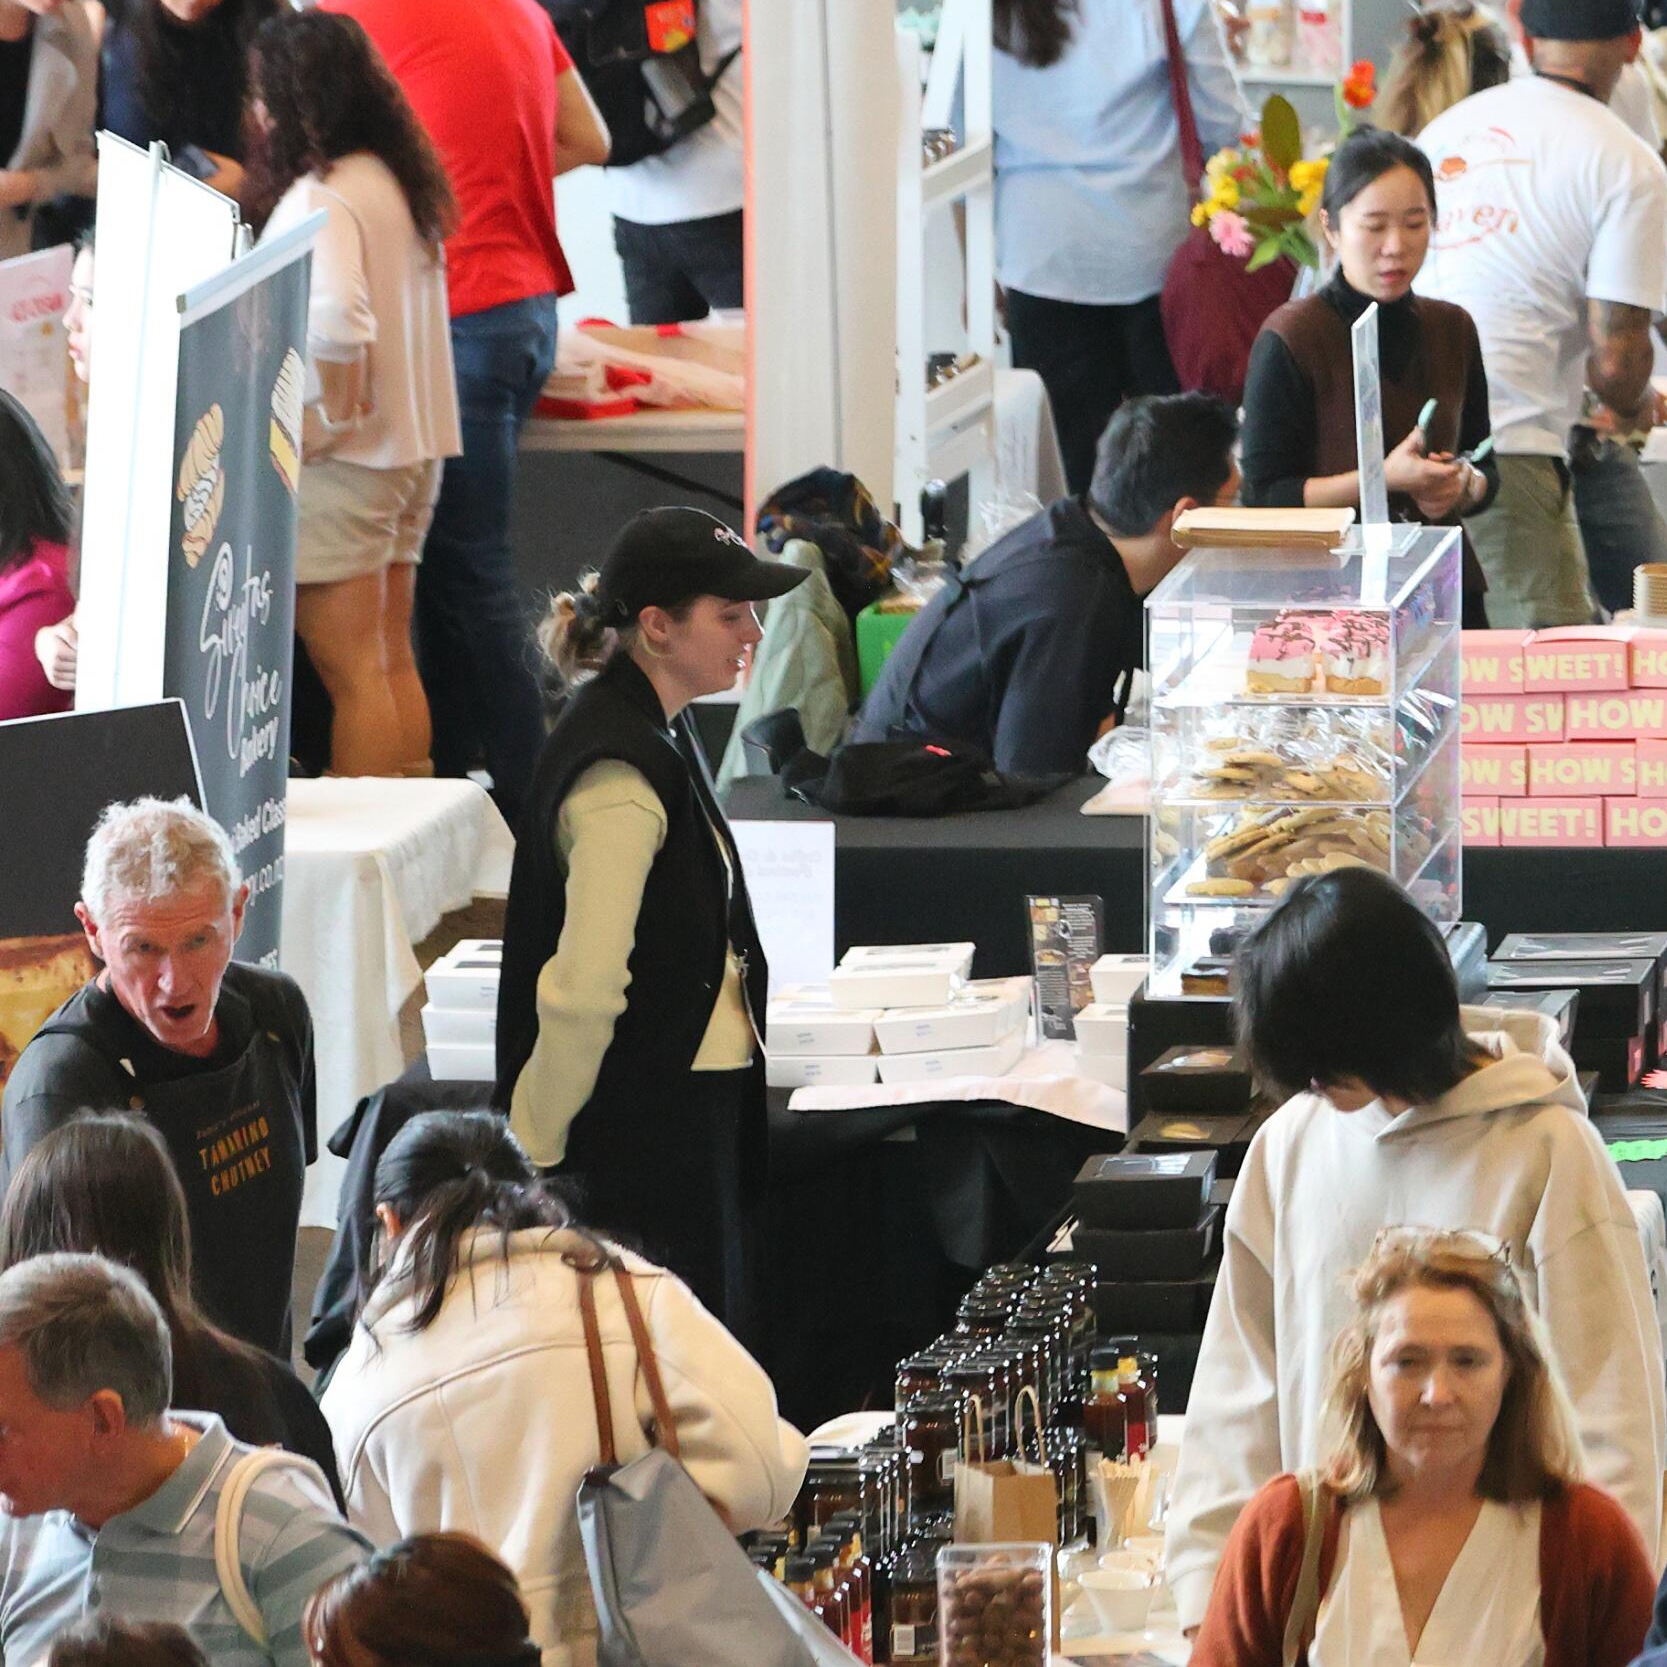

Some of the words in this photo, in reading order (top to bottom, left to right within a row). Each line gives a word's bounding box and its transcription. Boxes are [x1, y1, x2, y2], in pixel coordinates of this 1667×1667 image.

[1570, 699, 1667, 732] HOW
[1531, 755, 1614, 786] HOW
[199, 1116, 270, 1171] TAMARIND
[210, 1145, 272, 1197] CHUTNEY
